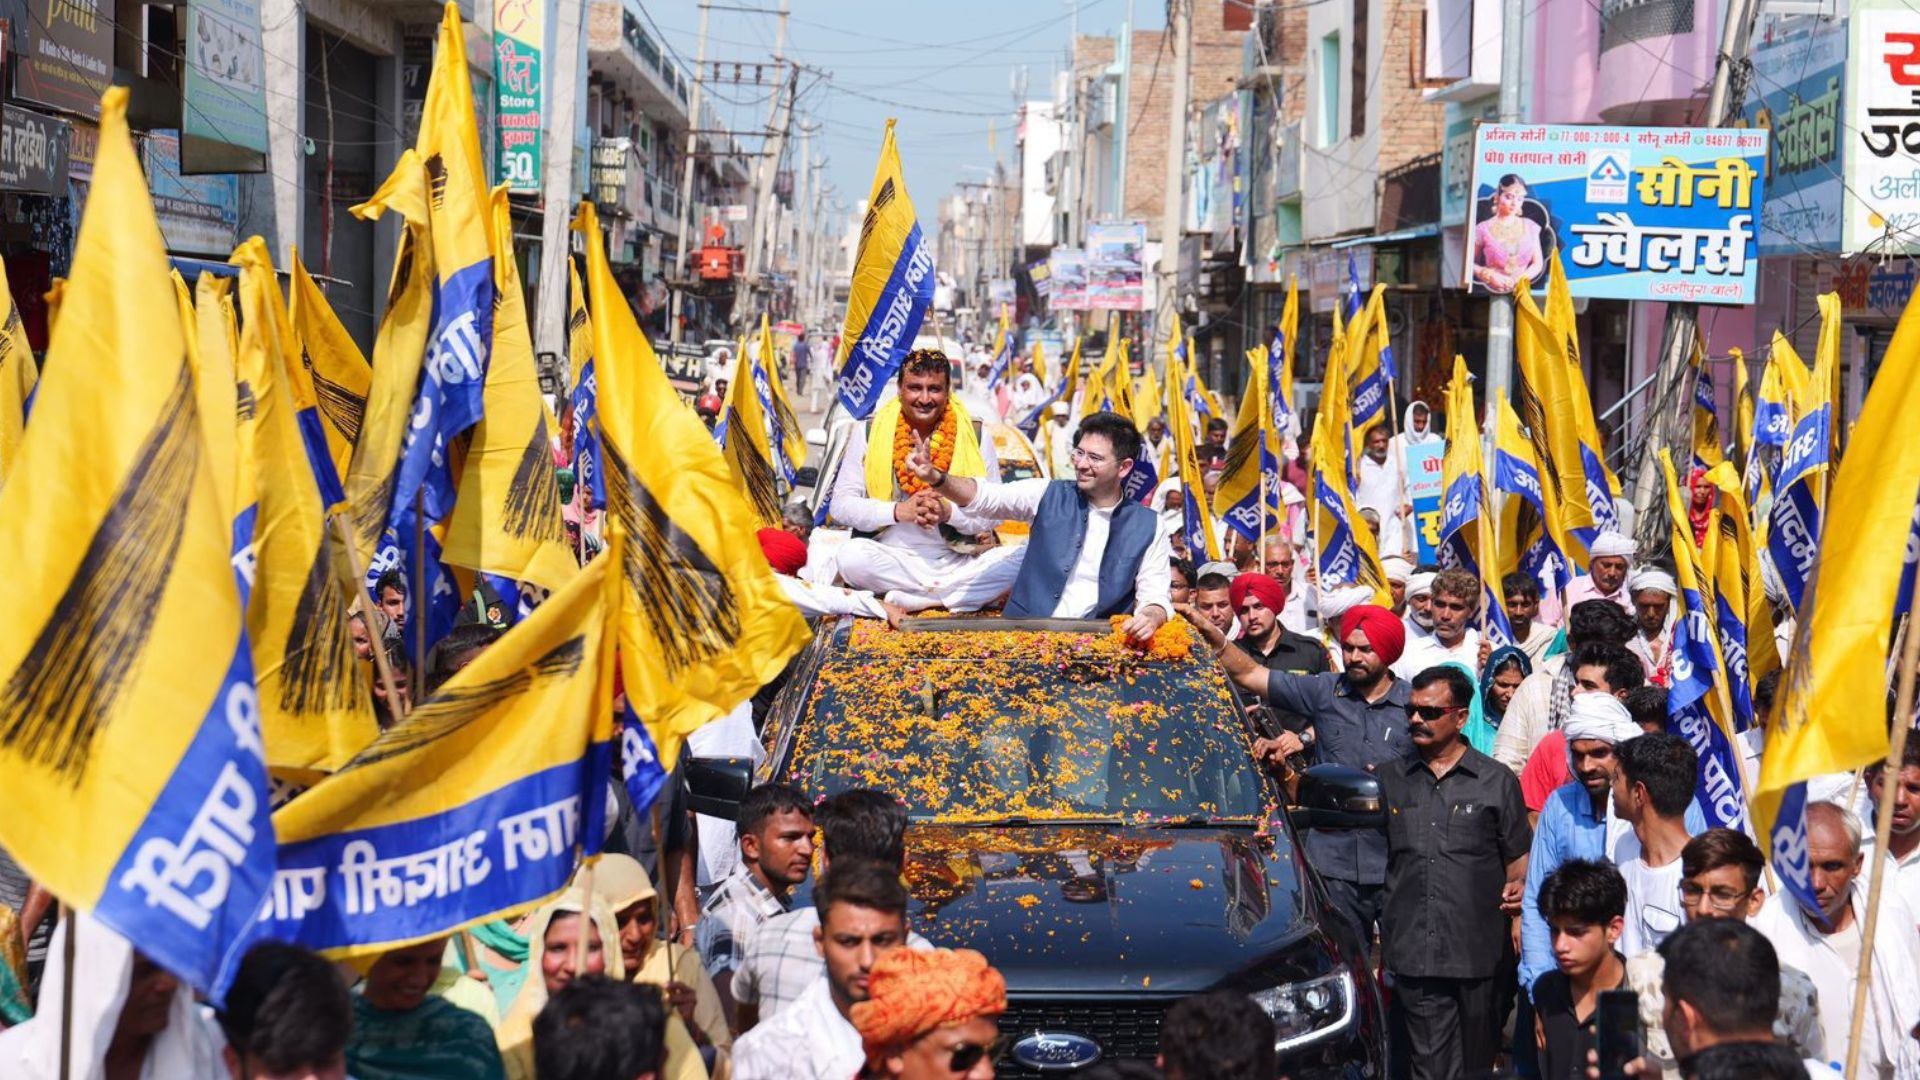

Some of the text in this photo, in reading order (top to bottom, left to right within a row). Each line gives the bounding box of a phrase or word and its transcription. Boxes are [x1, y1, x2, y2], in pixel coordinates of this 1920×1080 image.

[500, 96, 535, 108] Store
[1520, 128, 1546, 142] सोनी
[1664, 131, 1690, 145] सोनी
[1509, 151, 1553, 165] सतपाल
[1557, 150, 1587, 165] सोनी
[1635, 157, 1757, 209] सोनी
[1570, 211, 1754, 276] ज्वैलर्स
